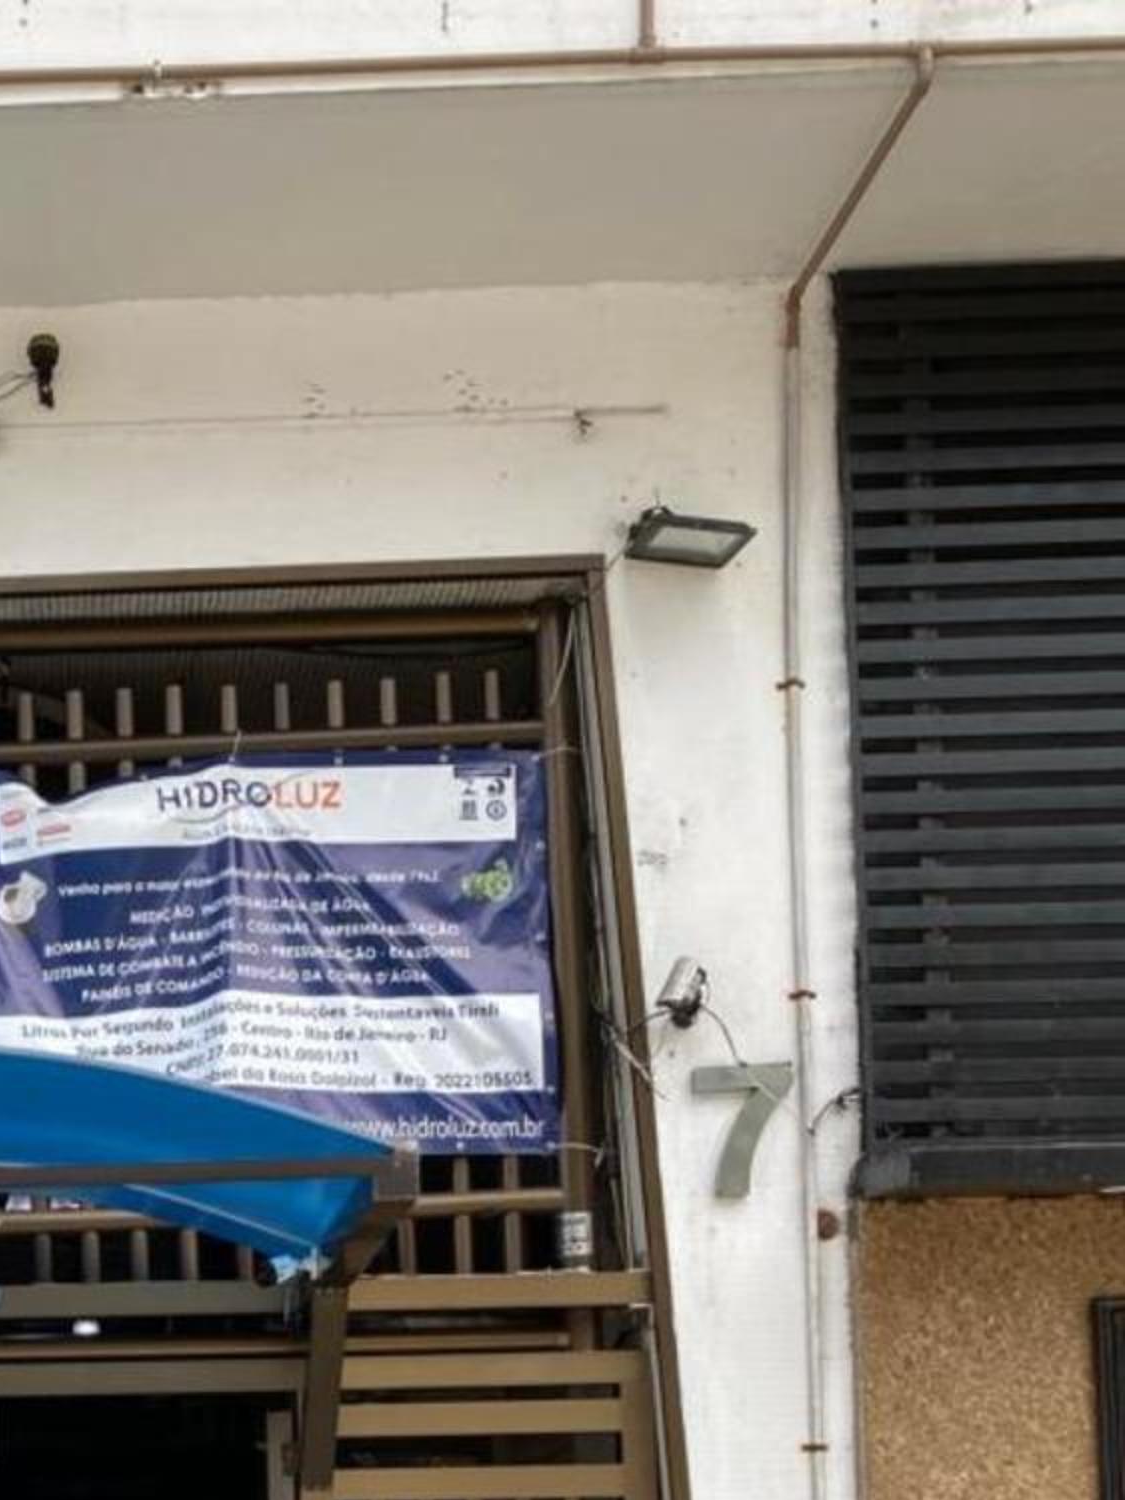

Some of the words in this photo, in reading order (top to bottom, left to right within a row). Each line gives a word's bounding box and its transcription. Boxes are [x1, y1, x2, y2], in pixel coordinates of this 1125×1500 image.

[156, 777, 342, 812] HIDROLUZ
[44, 938, 101, 958] BOMBAS
[98, 962, 115, 976] DE
[118, 954, 184, 976] COMBATE
[135, 978, 153, 996] DE
[156, 966, 225, 993] COMANDO
[102, 1015, 174, 1036] Segundo
[277, 1001, 347, 1022] Soluções
[112, 1040, 133, 1056] do
[239, 1020, 294, 1041] Centro
[334, 1024, 353, 1041] de
[428, 1026, 448, 1042] RJ
[690, 1060, 794, 1204] 7
